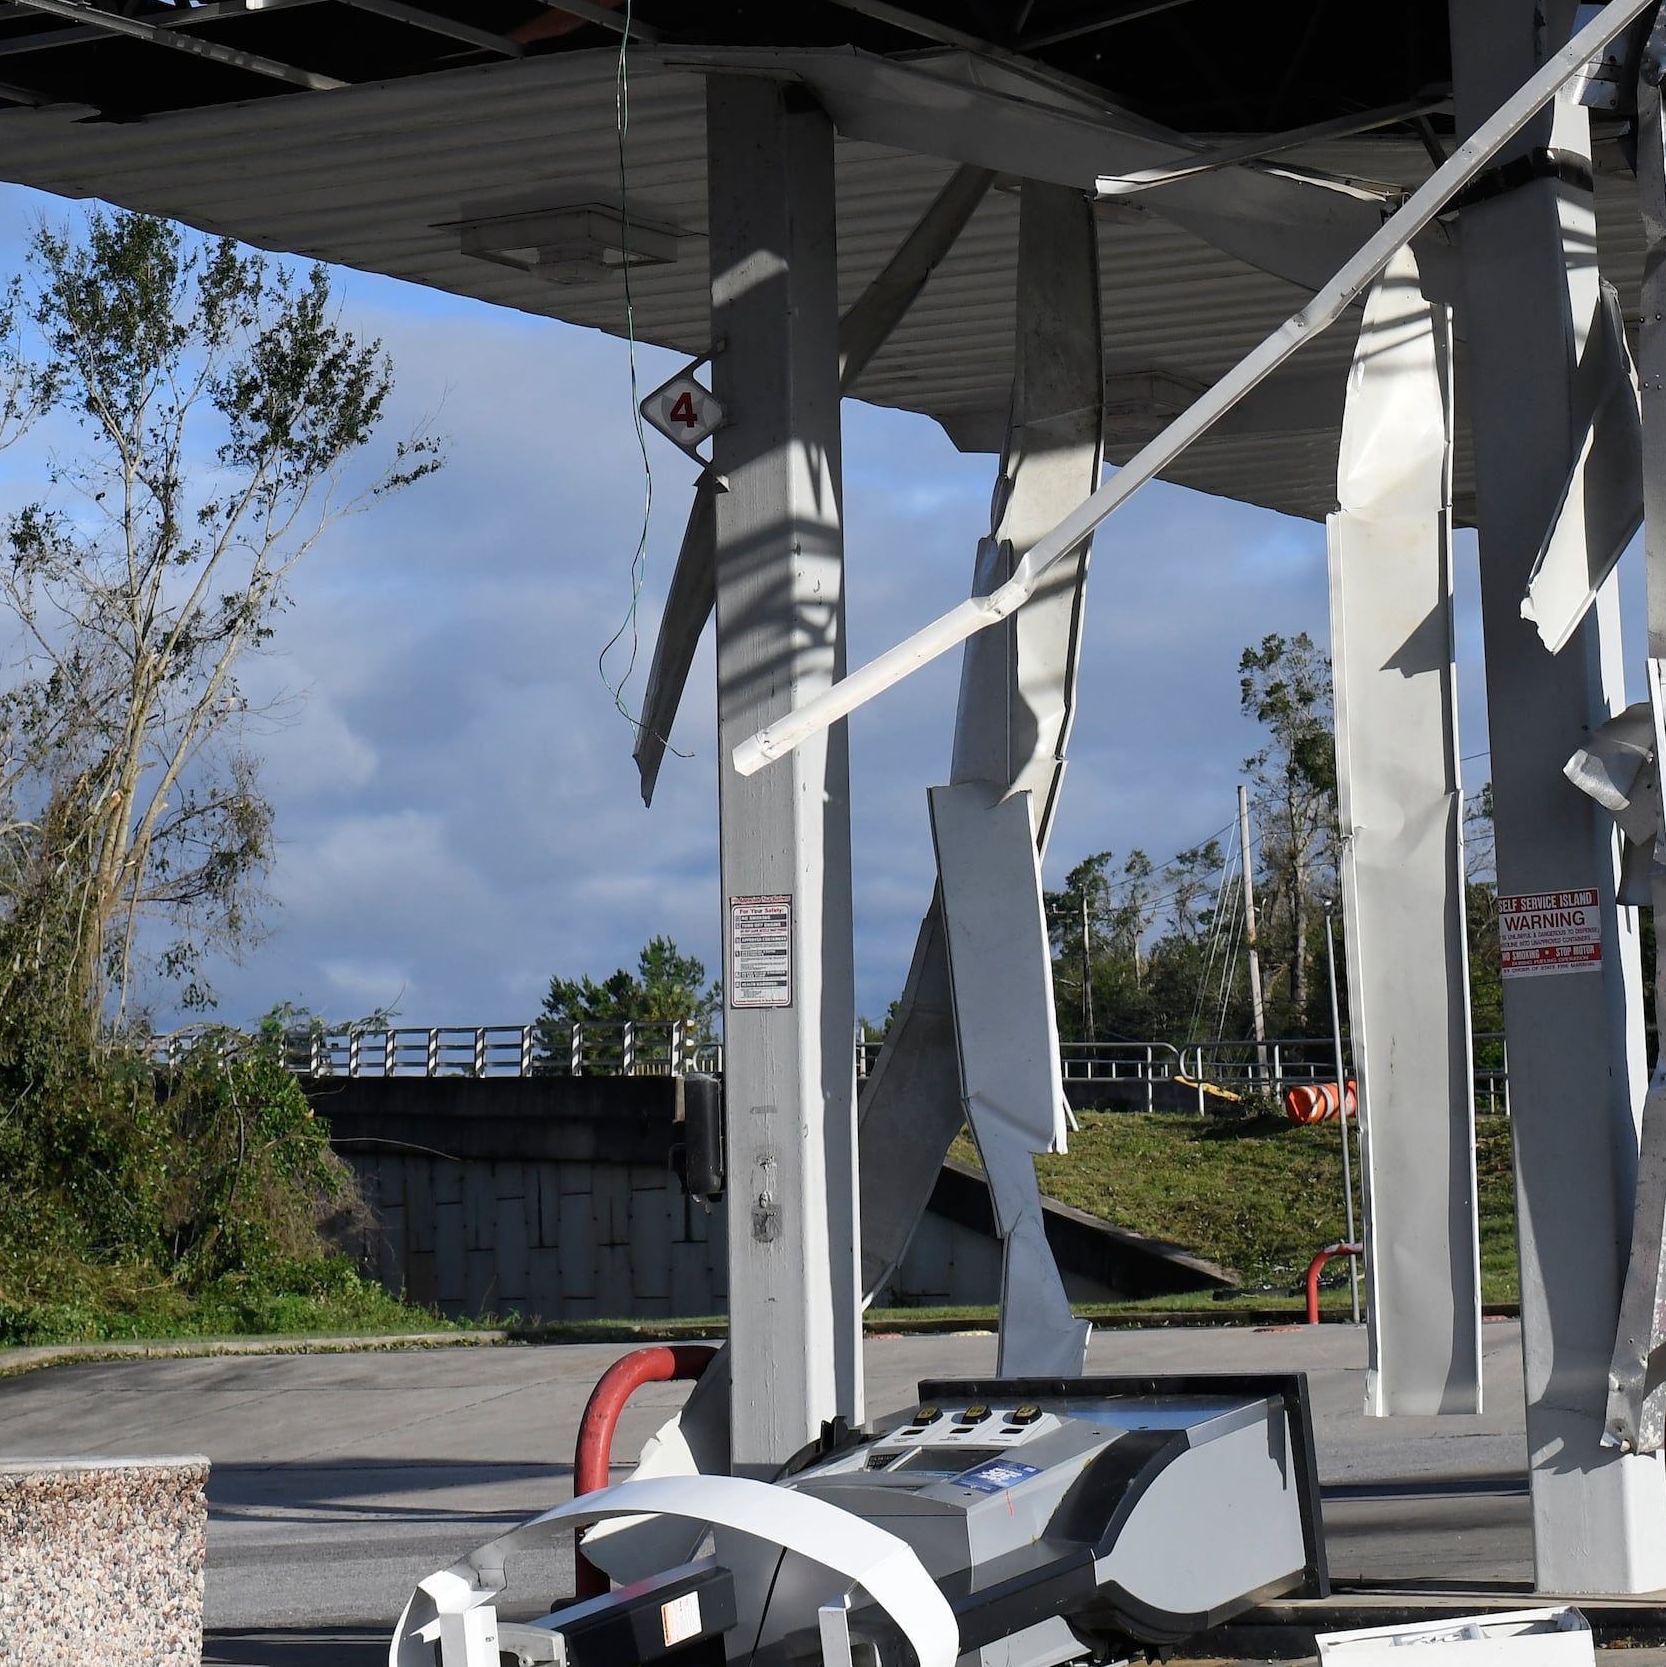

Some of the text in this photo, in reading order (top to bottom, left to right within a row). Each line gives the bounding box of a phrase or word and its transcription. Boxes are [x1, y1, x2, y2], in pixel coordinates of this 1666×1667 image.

[670, 392, 697, 428] 4
[1498, 892, 1593, 913] SELF SERVICE ISLAND
[1504, 910, 1585, 932] WARNING
[1555, 946, 1572, 957] STOP
